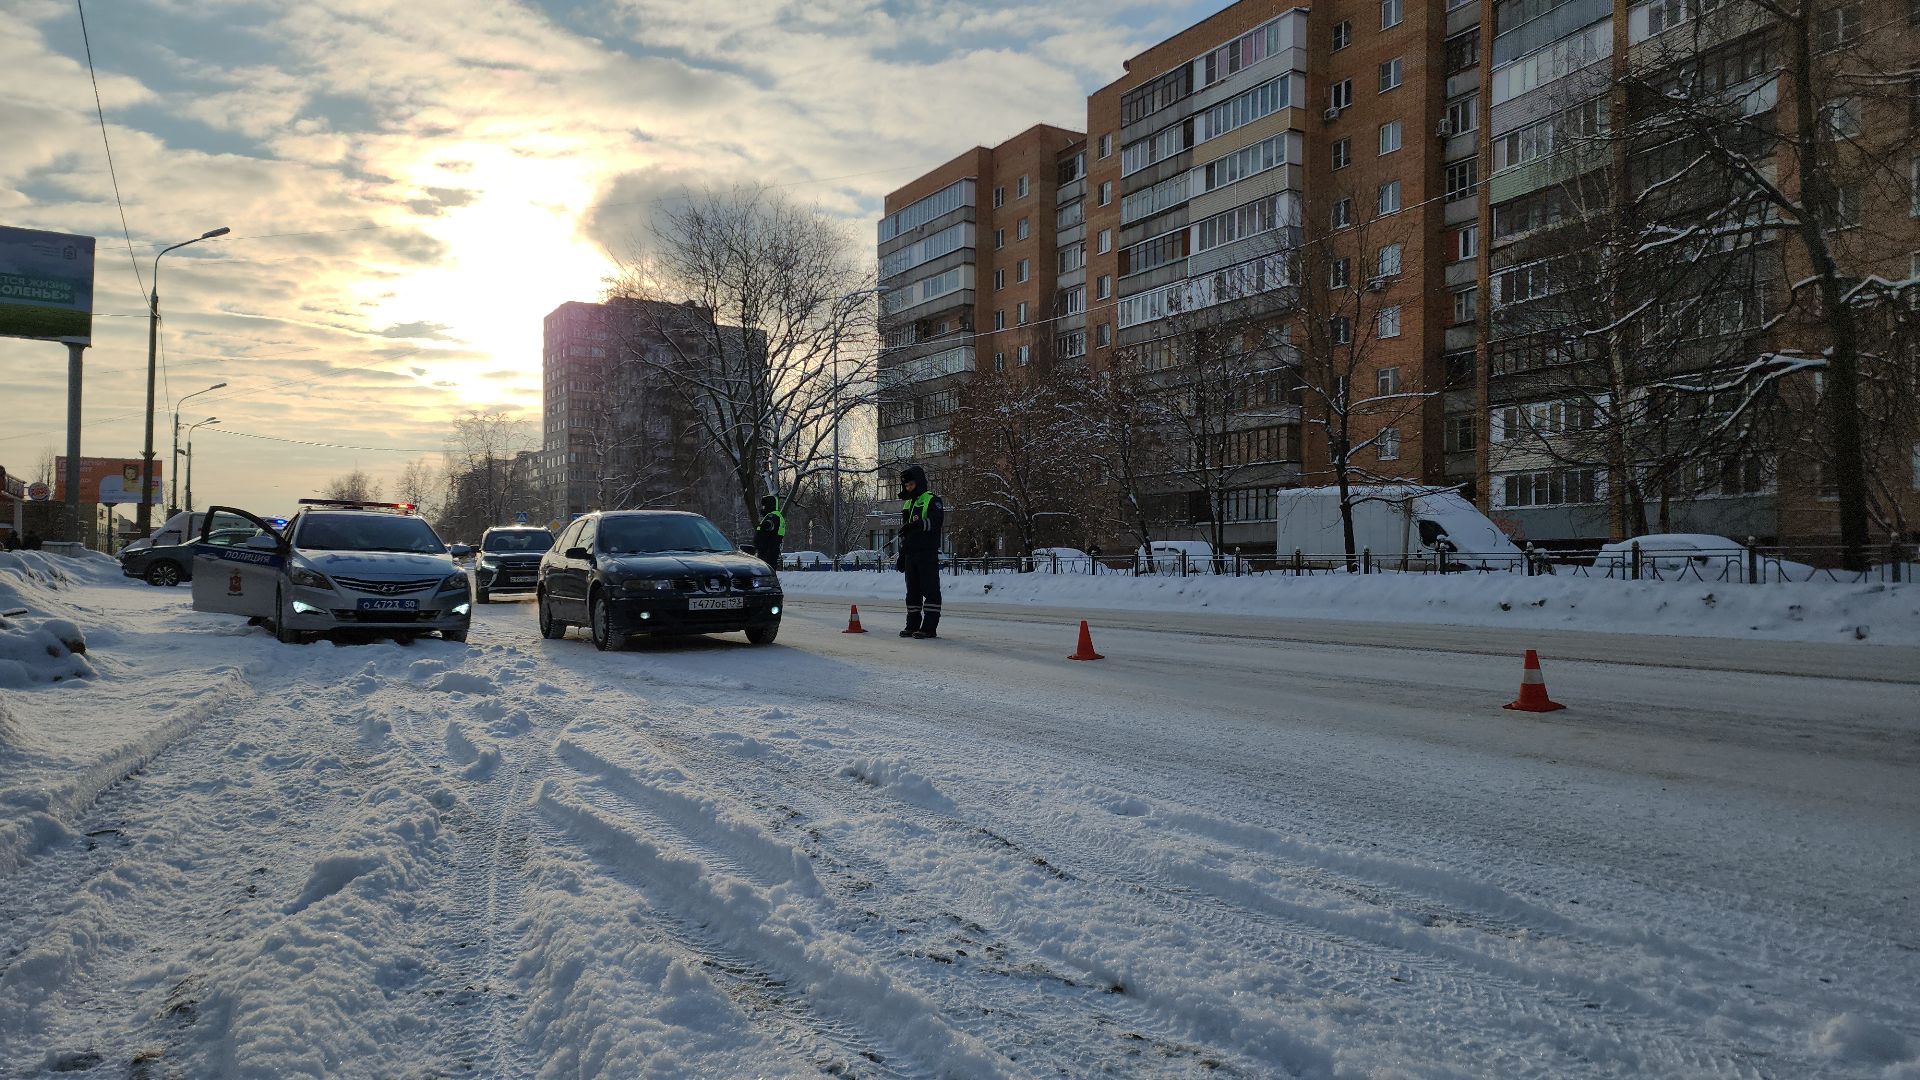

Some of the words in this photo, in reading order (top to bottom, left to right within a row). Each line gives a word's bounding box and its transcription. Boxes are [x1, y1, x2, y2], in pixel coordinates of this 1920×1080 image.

[28, 279, 72, 291] ЖИЗНЬ
[0, 285, 70, 300] ОЛЕНЬЕ»
[224, 550, 271, 564] ПОЛИЦИЯ
[373, 600, 399, 609] 4723
[404, 600, 415, 608] 50
